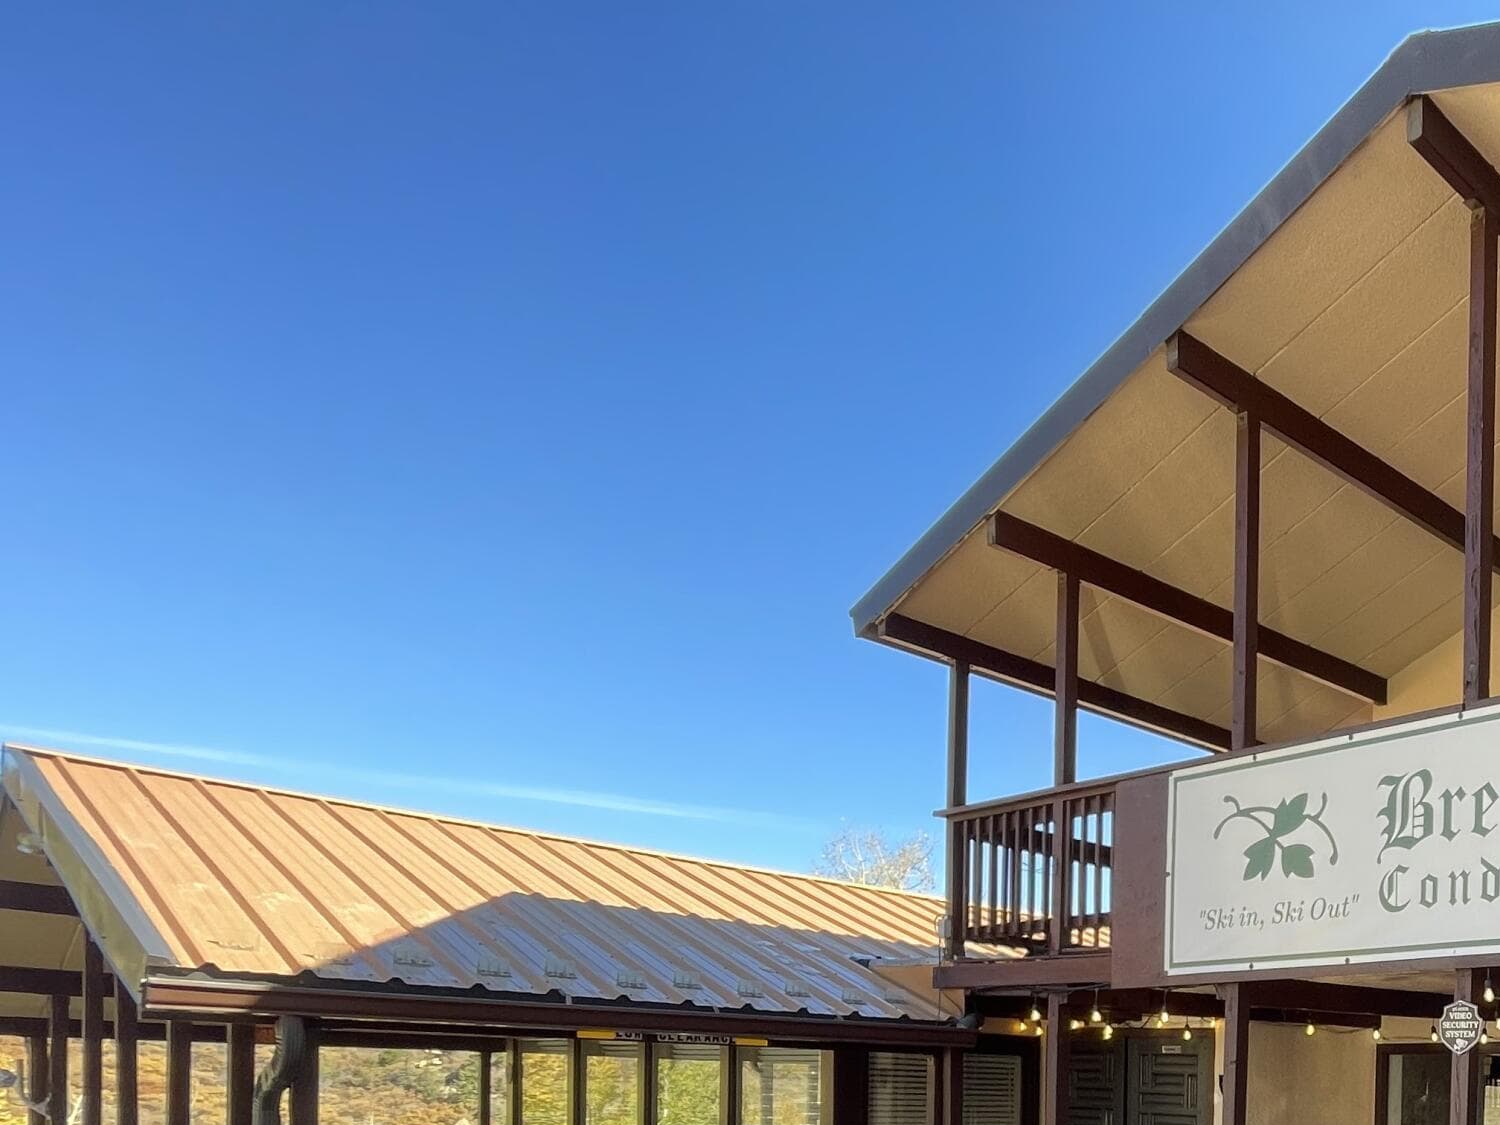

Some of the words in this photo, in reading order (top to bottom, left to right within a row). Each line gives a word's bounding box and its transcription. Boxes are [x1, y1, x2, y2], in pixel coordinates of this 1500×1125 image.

[1200, 906, 1235, 931] "Ski
[1239, 906, 1265, 931] in,
[1272, 900, 1304, 924] Ski
[1310, 894, 1360, 921] Out"
[1449, 1011, 1472, 1020] VIDEO
[1442, 1020, 1479, 1029] SECURITY
[1445, 1030, 1476, 1038] SYSTEM
